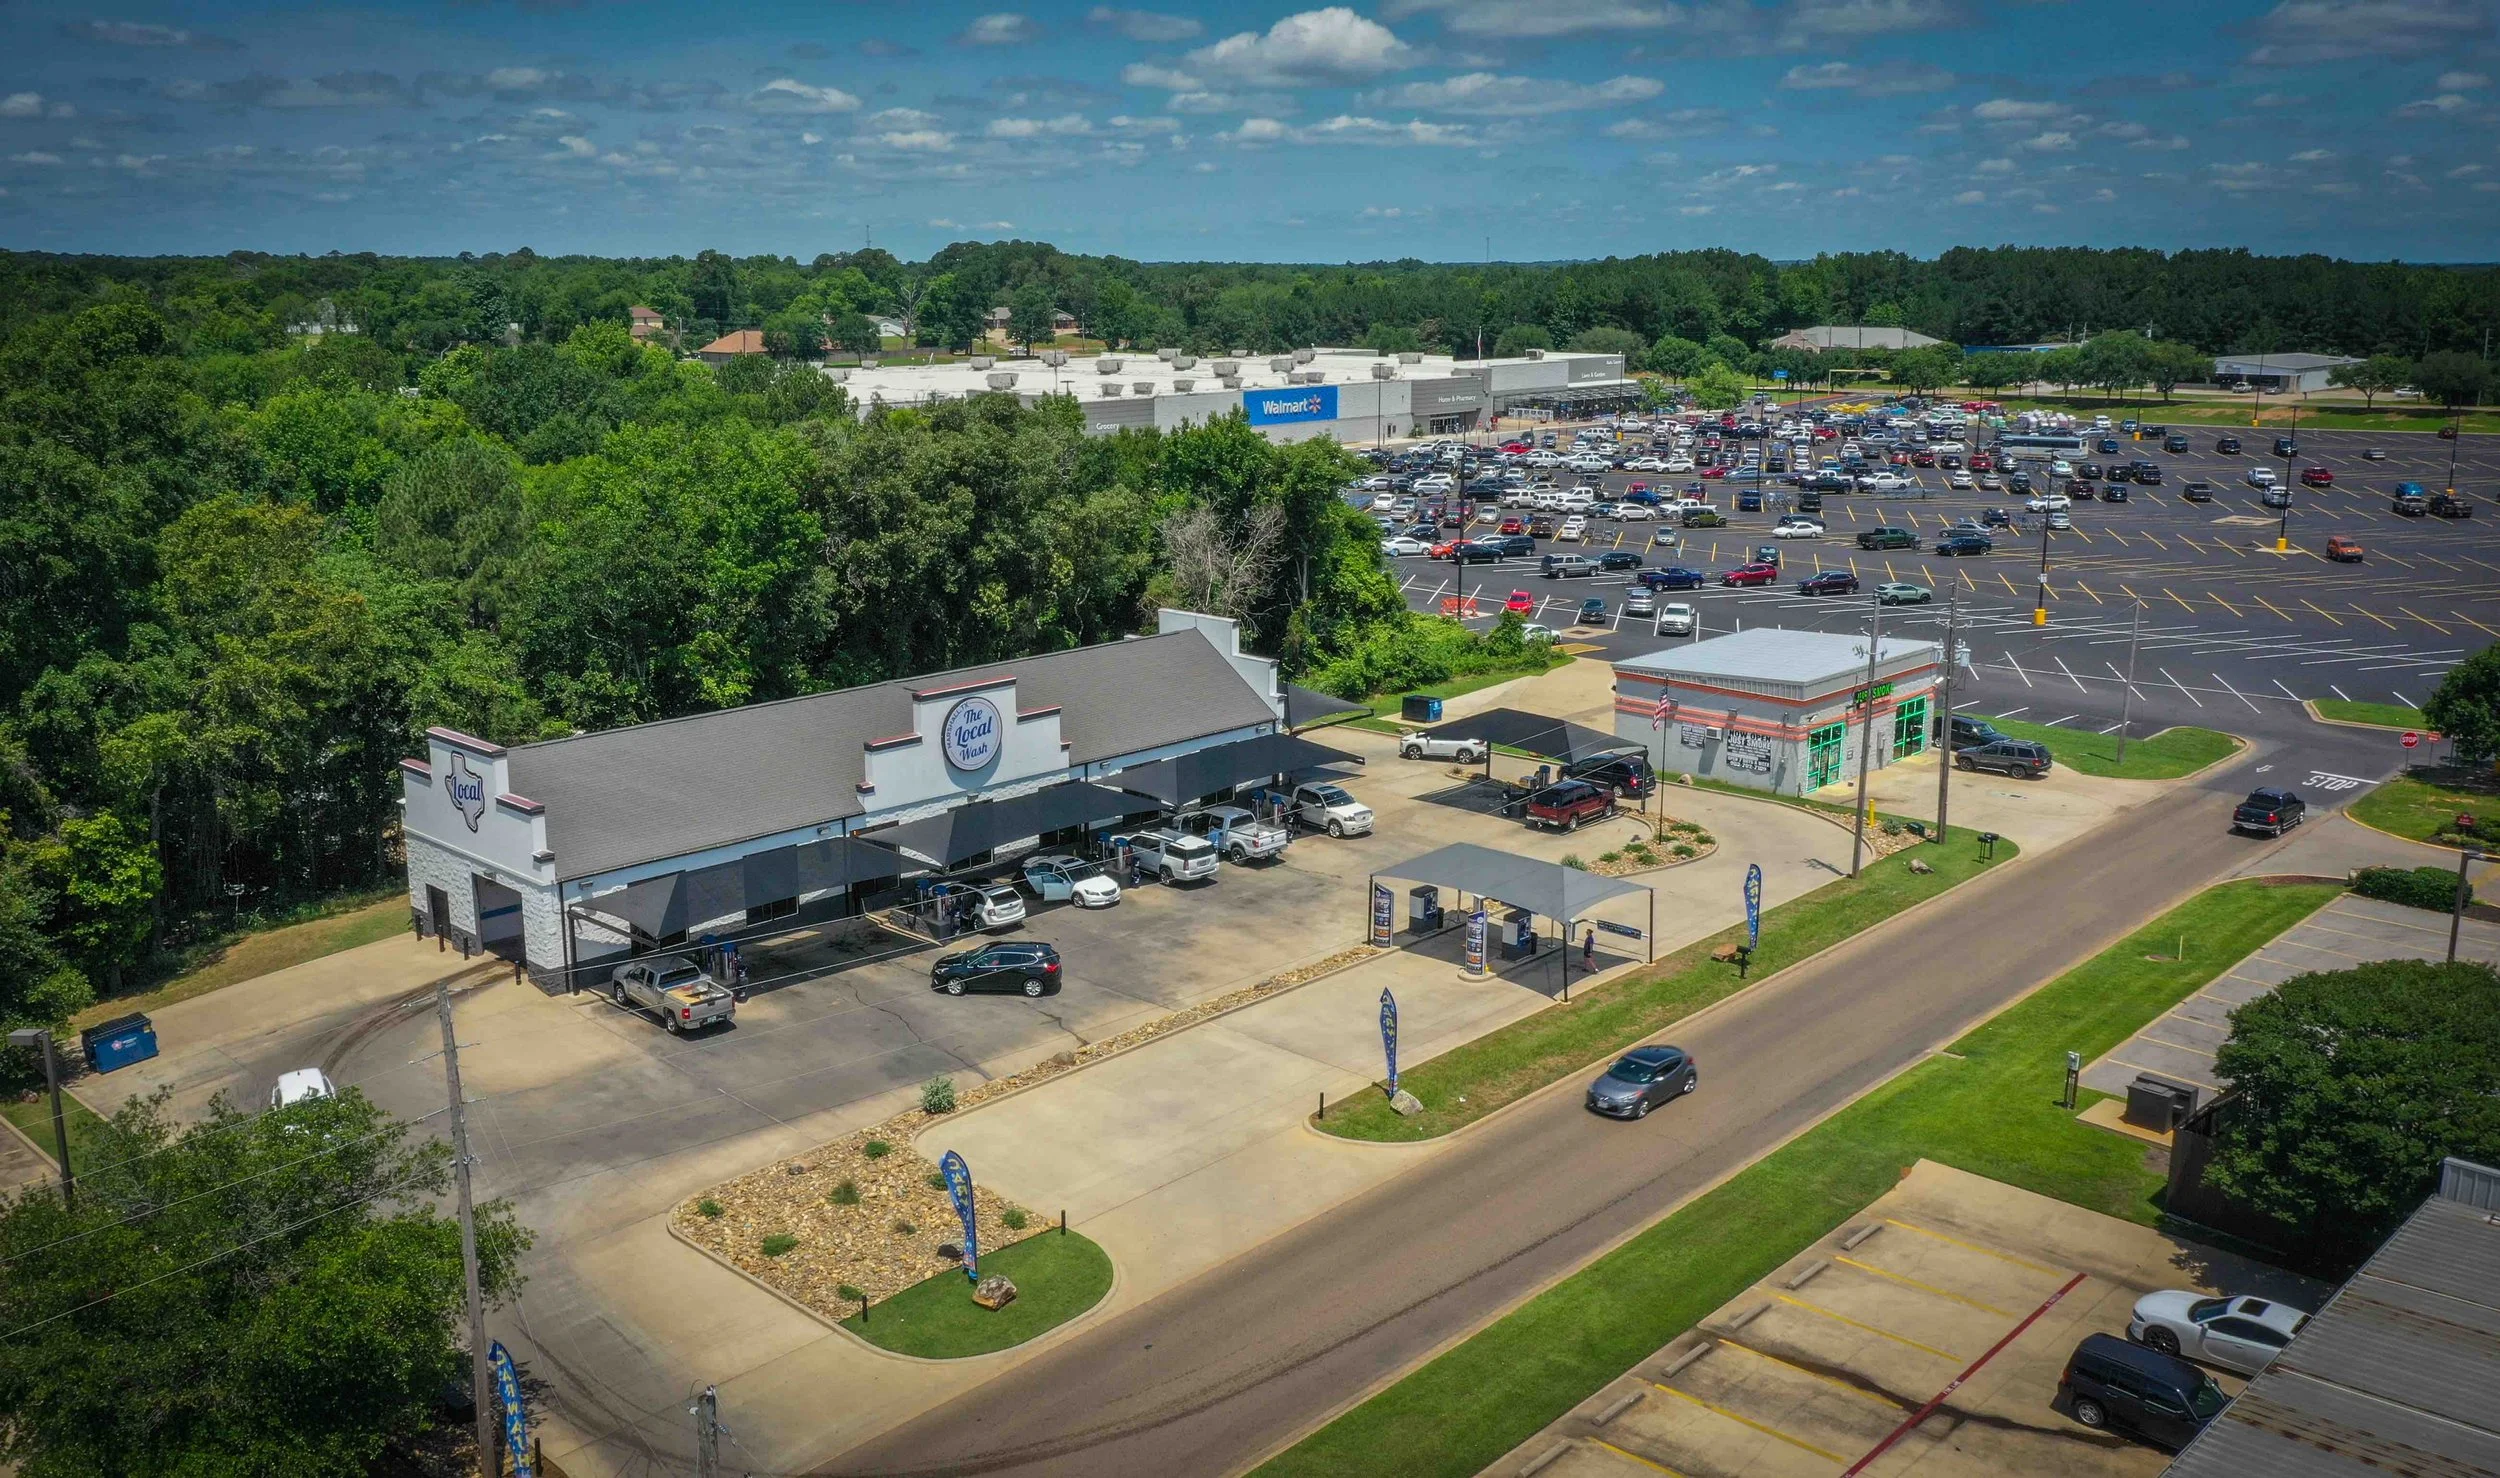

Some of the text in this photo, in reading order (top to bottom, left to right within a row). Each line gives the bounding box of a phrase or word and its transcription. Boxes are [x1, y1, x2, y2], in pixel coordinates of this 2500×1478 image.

[1262, 398, 1308, 415] Walmart
[1096, 422, 1119, 432] Grocery
[1856, 690, 1869, 704] JUS
[964, 709, 982, 724] The
[955, 716, 992, 748] Local
[1729, 729, 1771, 742] NOW OPEN
[1728, 735, 1771, 750] JUST SMOKE
[2401, 736, 2417, 744] STOP
[960, 742, 988, 761] Wash
[2302, 775, 2358, 791] STOP
[452, 776, 481, 806] Local
